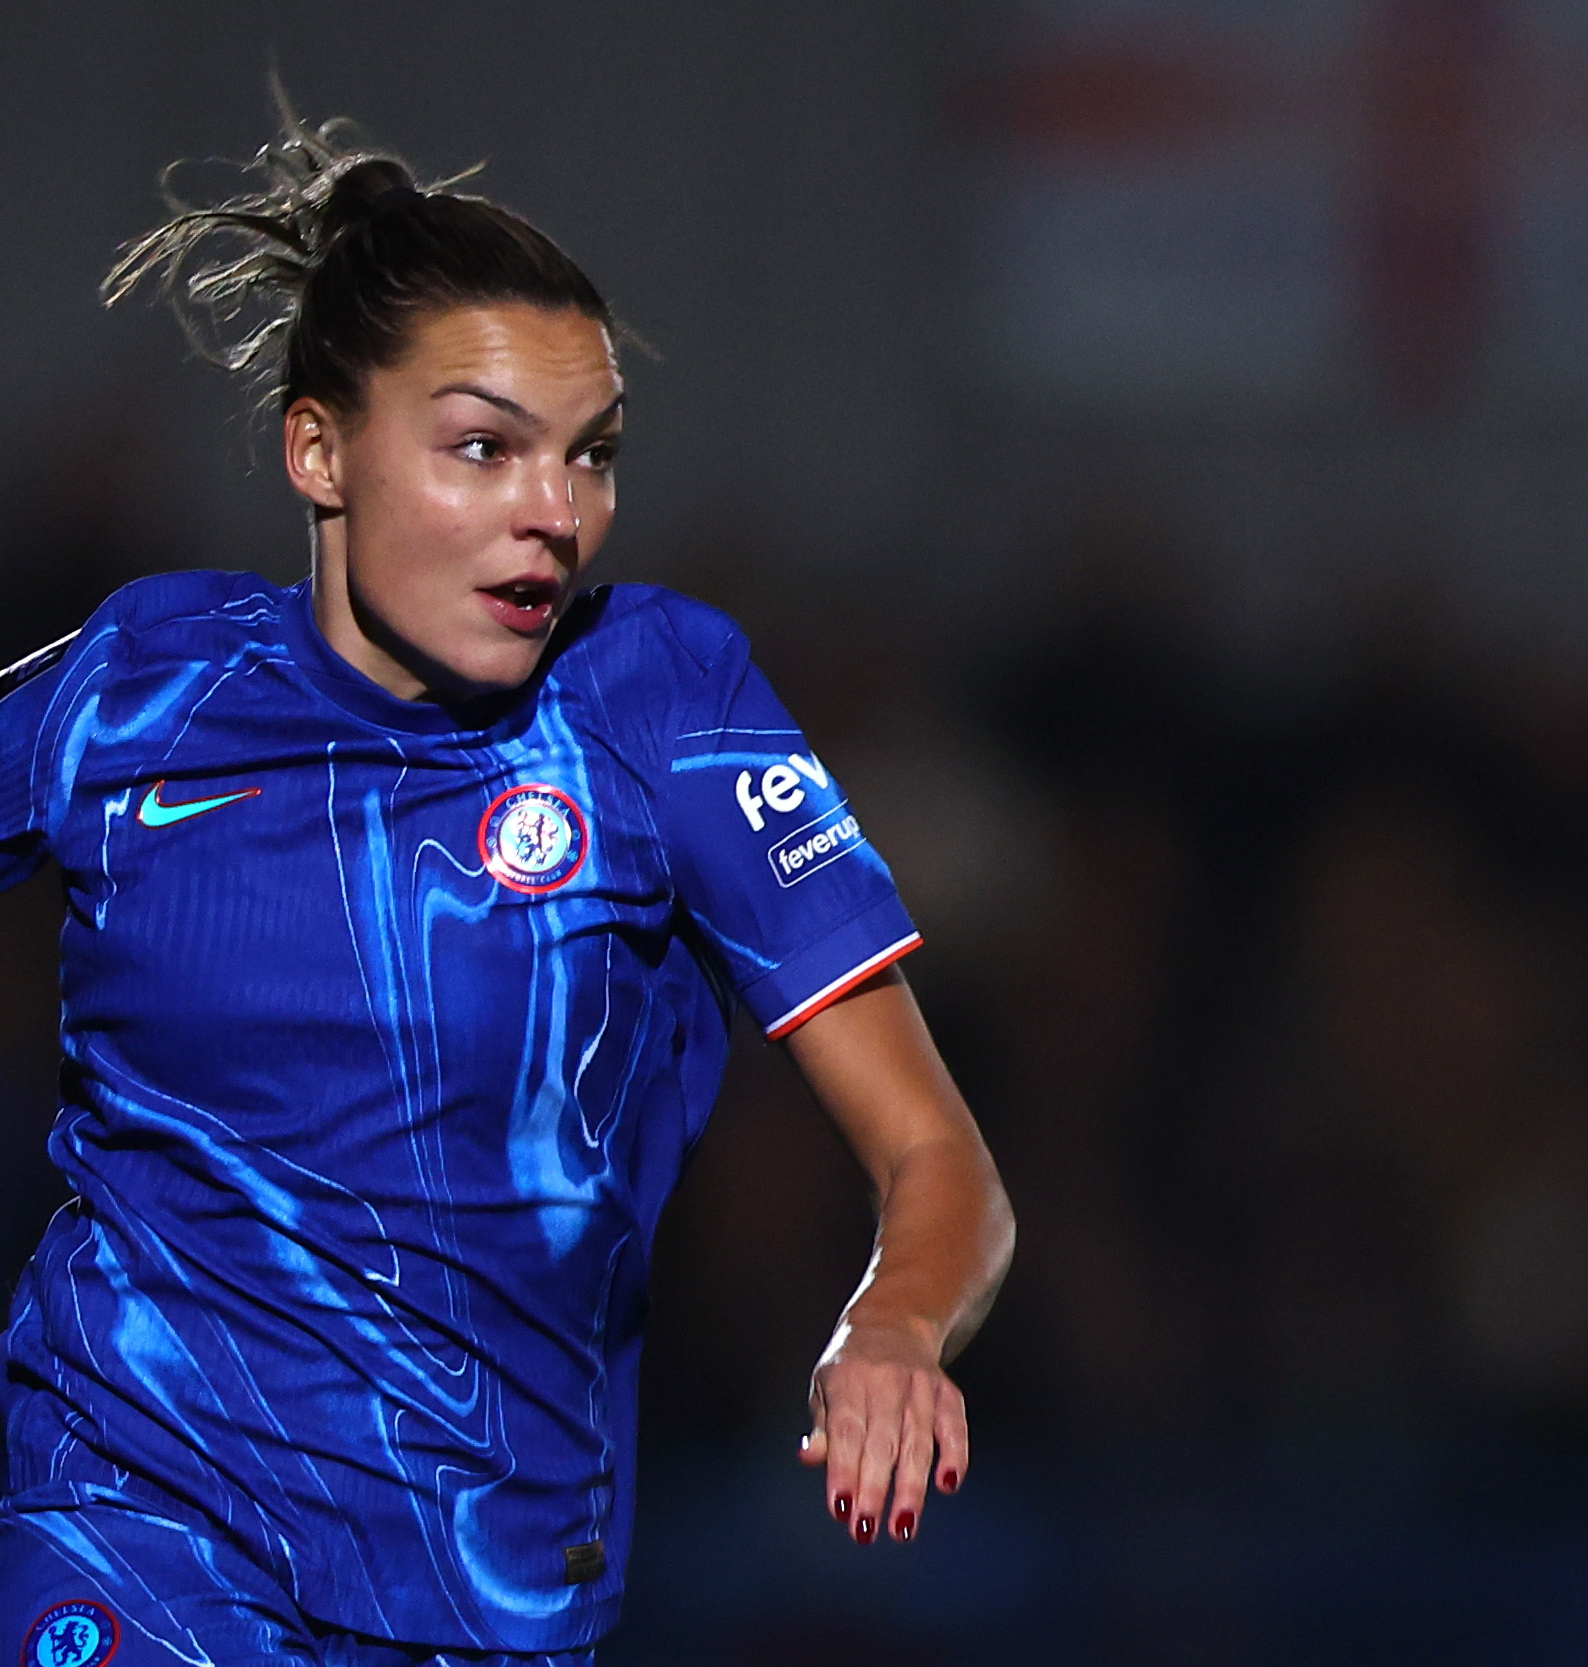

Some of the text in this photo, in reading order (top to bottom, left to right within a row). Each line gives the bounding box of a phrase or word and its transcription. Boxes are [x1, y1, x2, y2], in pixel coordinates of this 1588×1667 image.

[506, 791, 571, 817] CHELSEA
[735, 750, 828, 832] fev
[36, 1604, 96, 1631] CHELSEA
